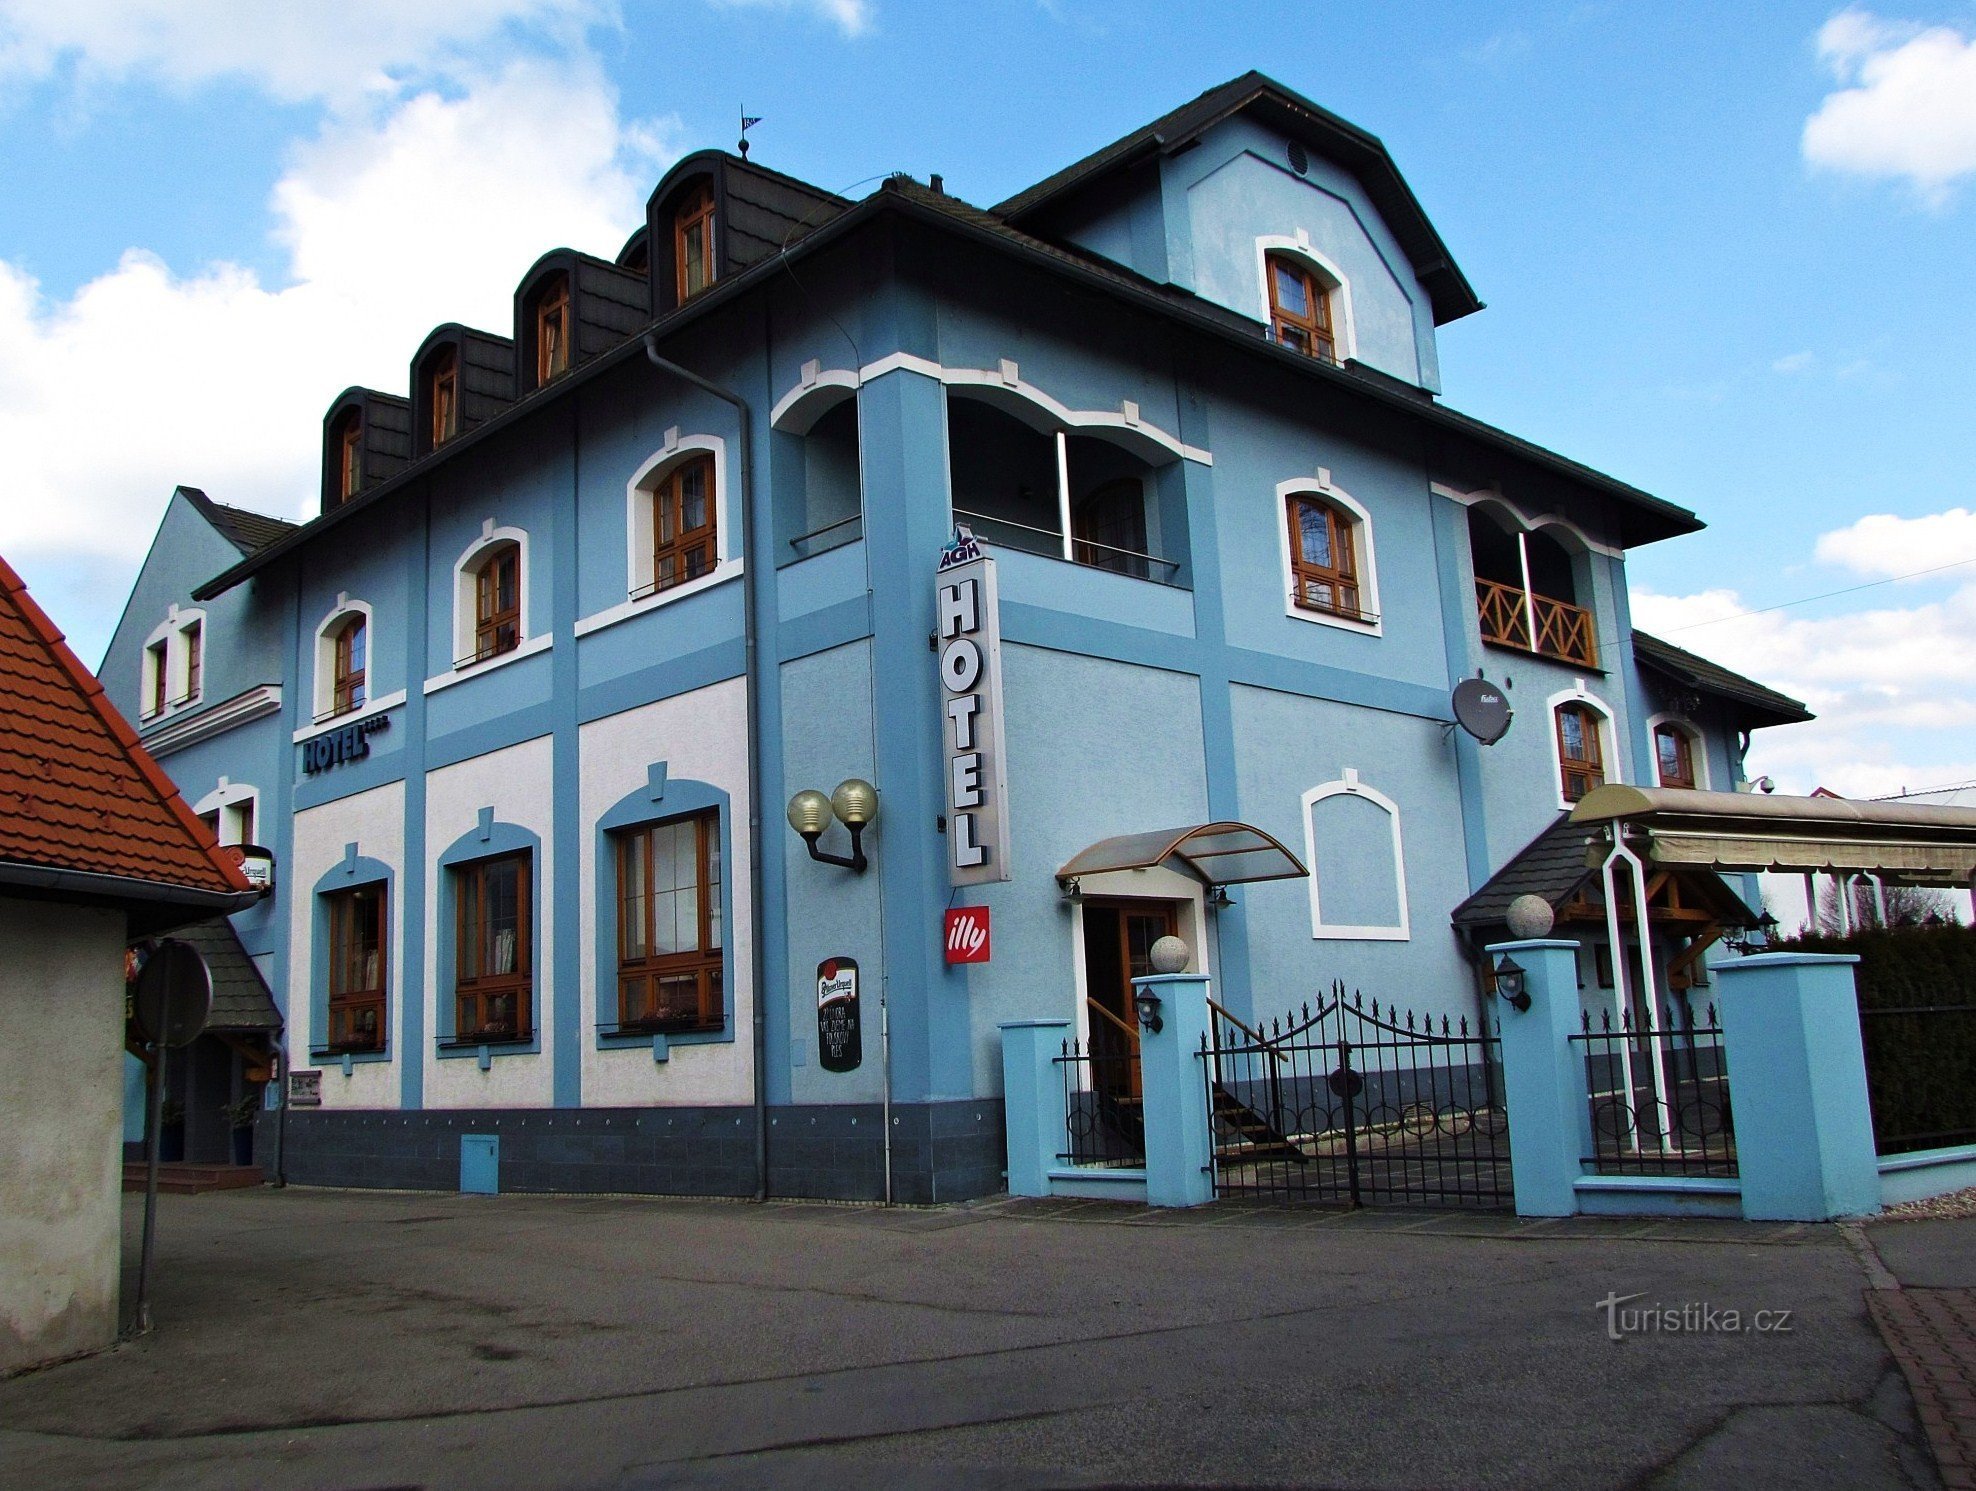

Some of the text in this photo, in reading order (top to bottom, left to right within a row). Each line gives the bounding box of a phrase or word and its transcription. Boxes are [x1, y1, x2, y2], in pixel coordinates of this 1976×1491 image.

[939, 542, 981, 569] AGH
[939, 578, 987, 868] HOTEL
[303, 725, 369, 773] HOTEL
[948, 915, 987, 958] illy
